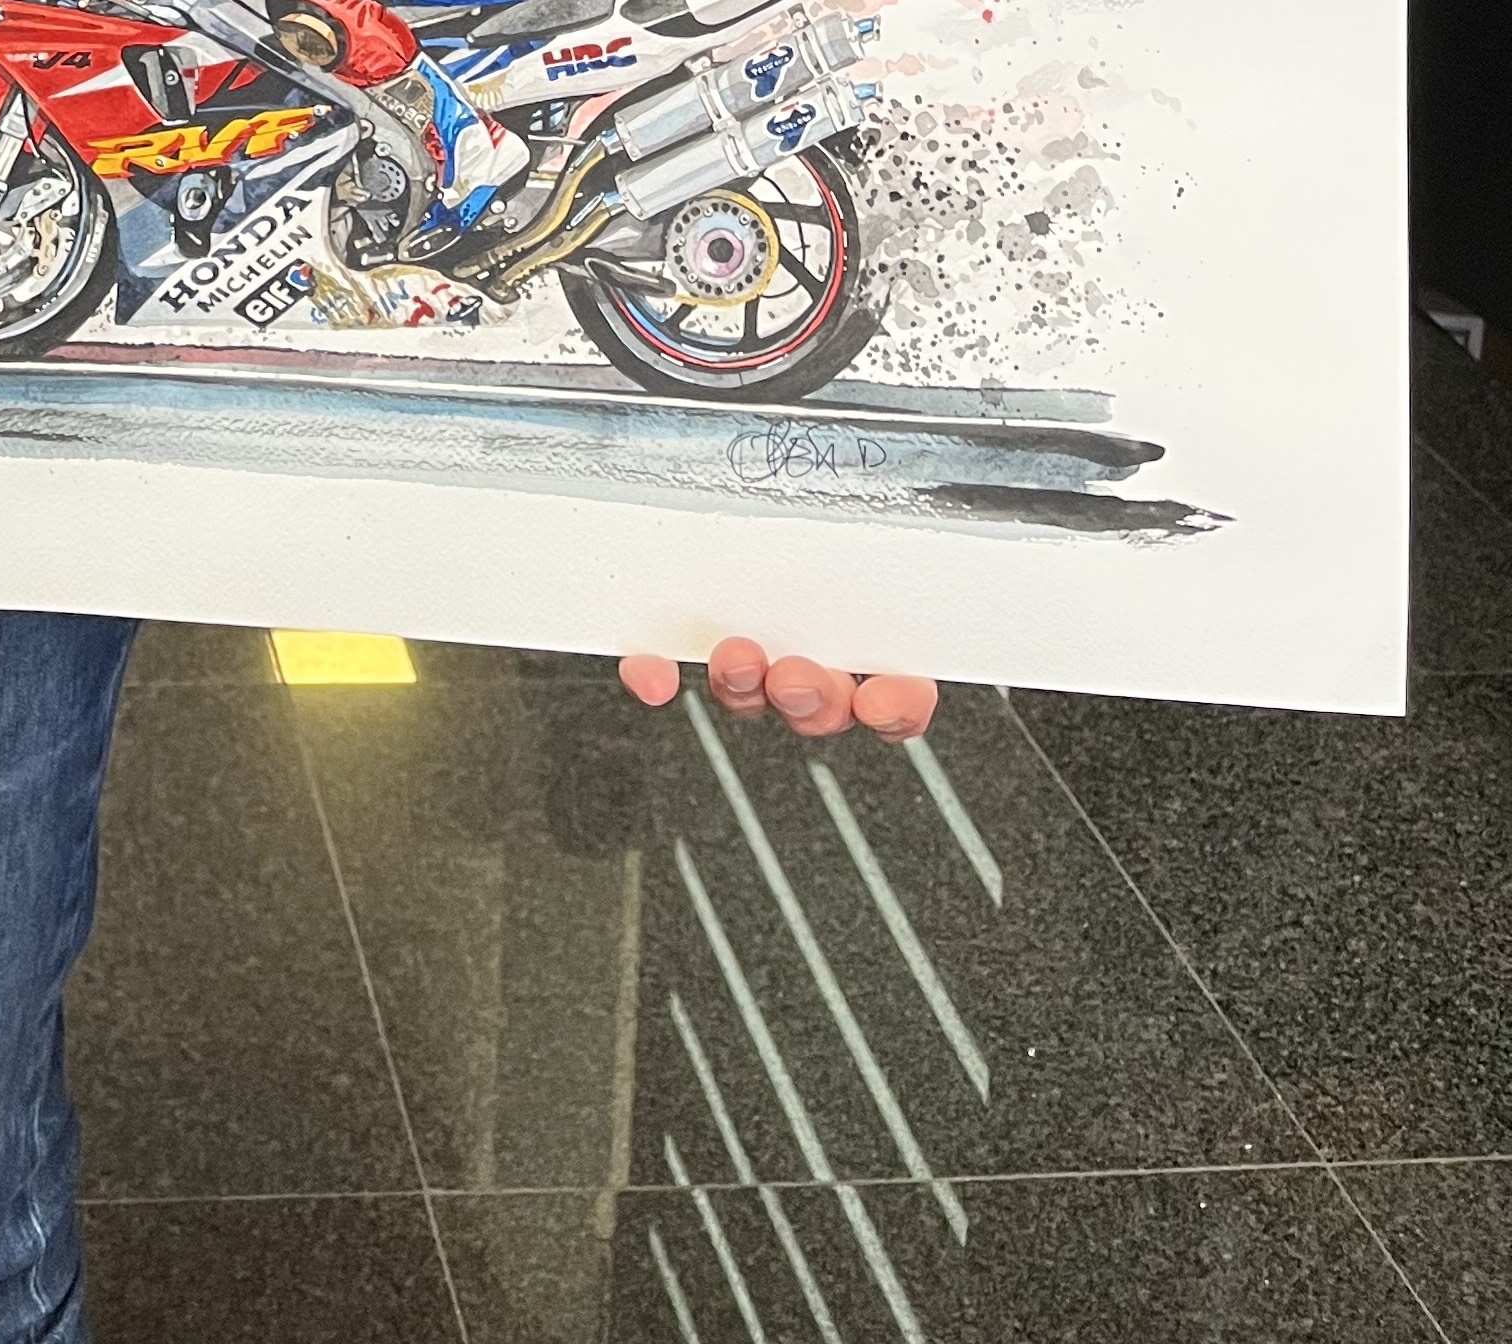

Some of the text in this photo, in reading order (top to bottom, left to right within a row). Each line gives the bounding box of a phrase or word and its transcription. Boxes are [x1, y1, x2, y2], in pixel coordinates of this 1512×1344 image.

[542, 36, 638, 81] HRC
[88, 105, 332, 179] RVF
[159, 195, 313, 313] HONDA
[197, 224, 313, 313] MICHELIN
